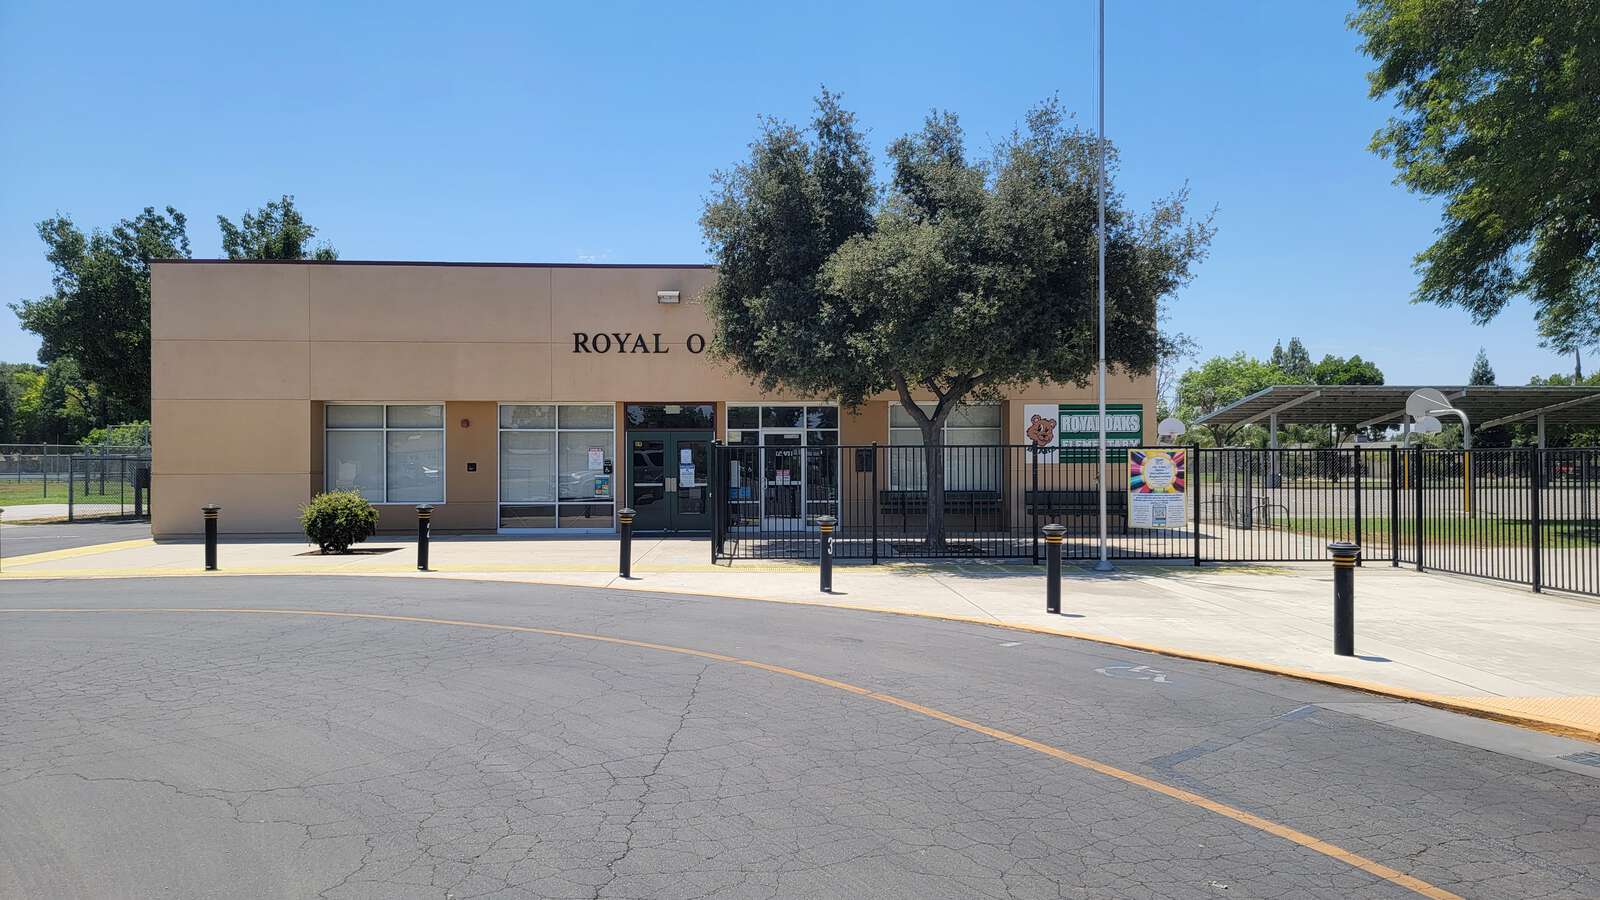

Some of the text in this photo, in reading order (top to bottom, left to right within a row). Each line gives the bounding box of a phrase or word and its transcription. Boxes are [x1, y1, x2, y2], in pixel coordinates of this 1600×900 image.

[572, 332, 670, 354] ROYAL
[1105, 414, 1140, 432] OAKS
[1061, 439, 1140, 450] ELEMETARY
[827, 536, 833, 555] 3
